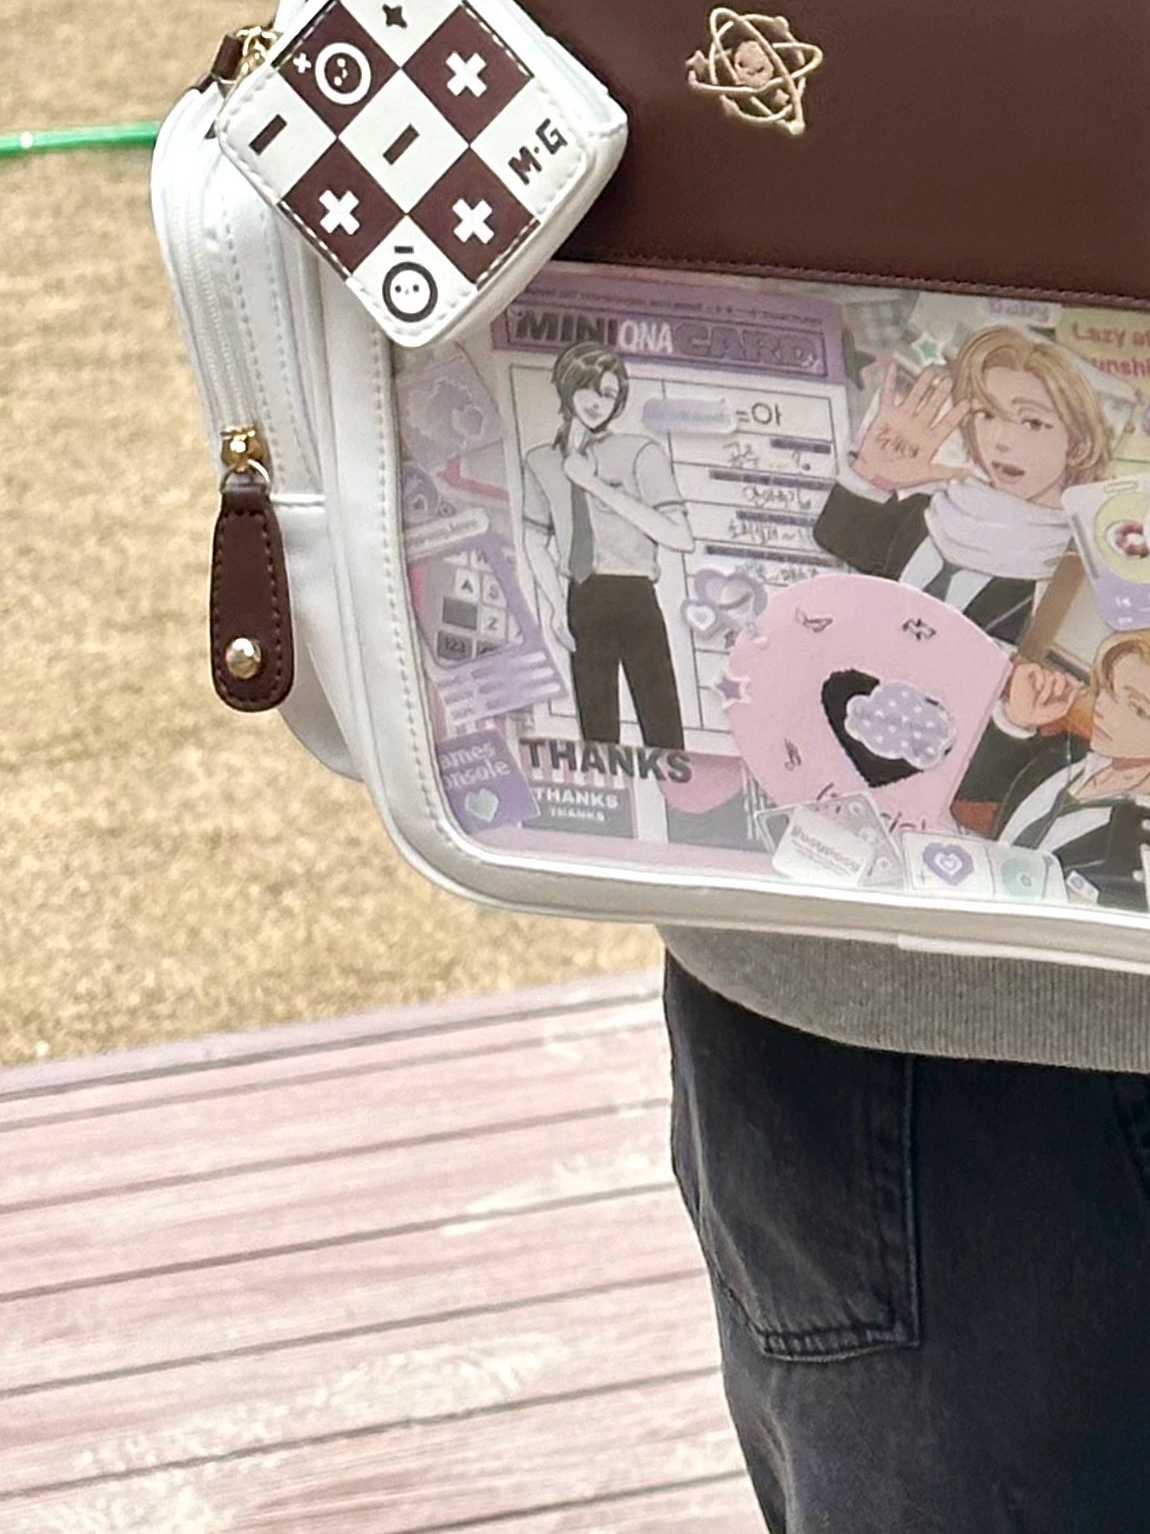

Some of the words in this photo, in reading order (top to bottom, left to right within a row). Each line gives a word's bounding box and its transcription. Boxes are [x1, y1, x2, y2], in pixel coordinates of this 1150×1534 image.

[1072, 321, 1127, 348] Lazy
[439, 741, 496, 769] ames
[519, 736, 693, 783] THANKS
[444, 758, 511, 790] onsole
[535, 788, 619, 810] THANKS
[551, 808, 605, 822] THANKS
